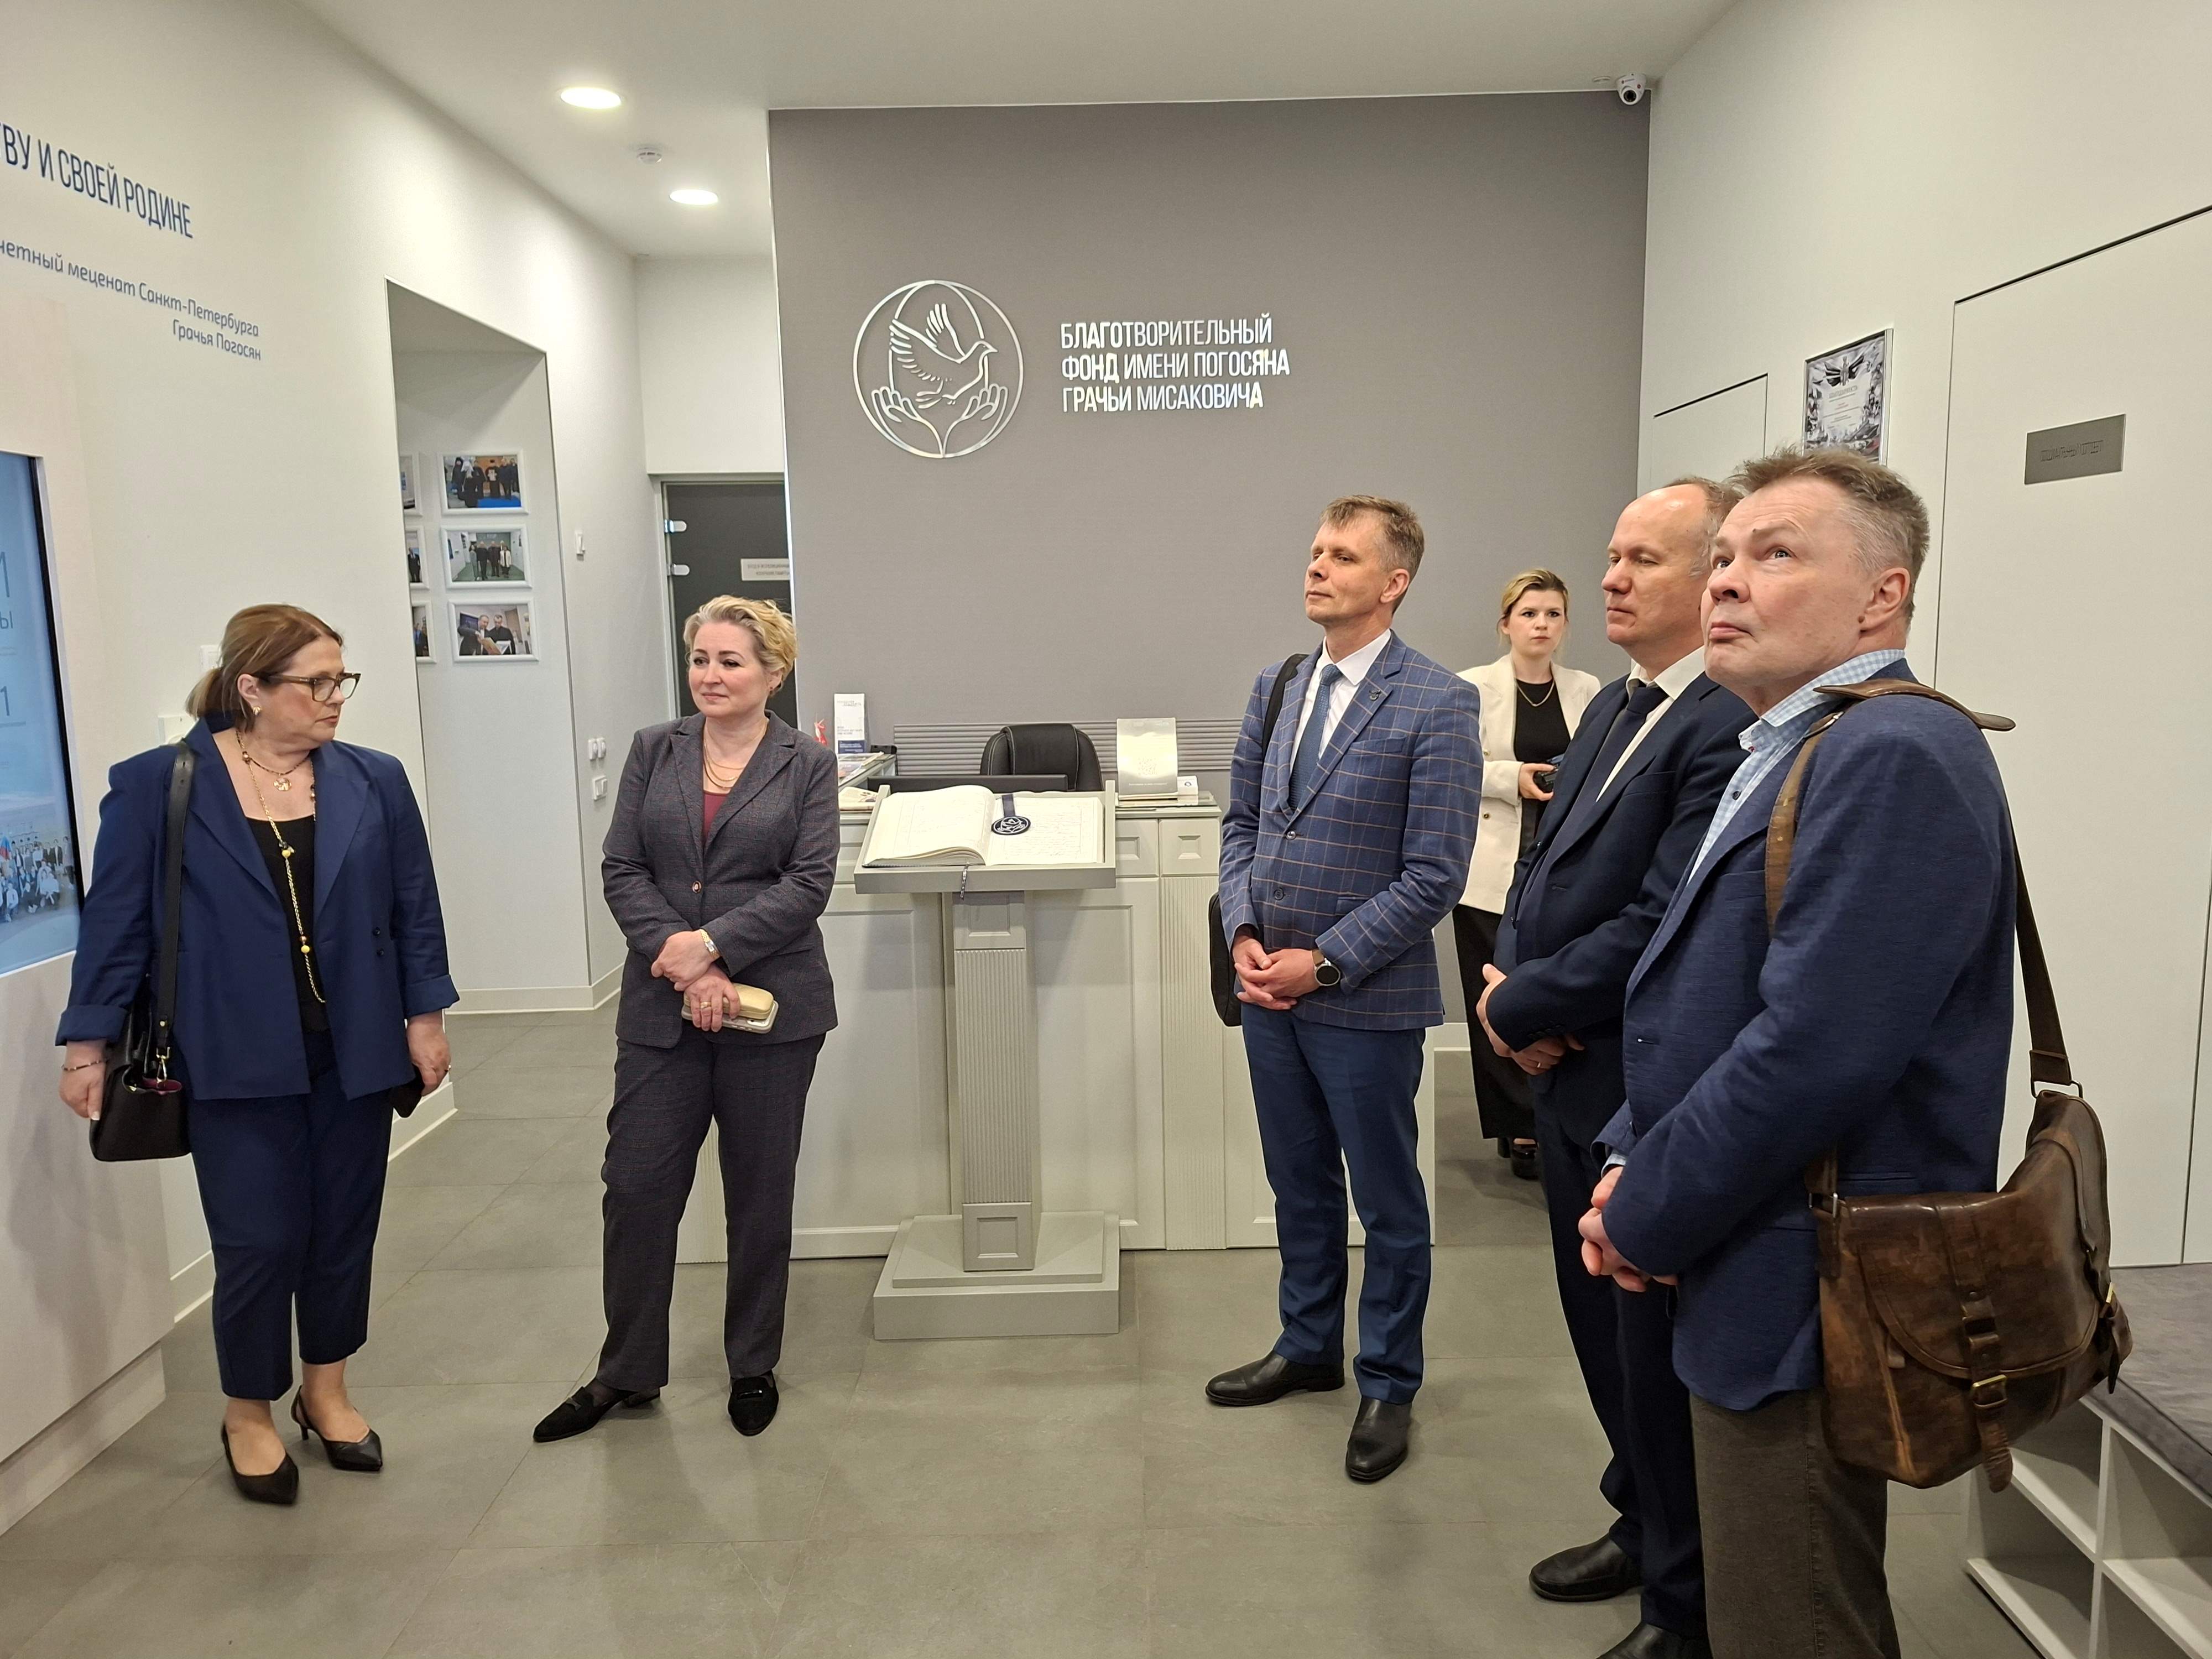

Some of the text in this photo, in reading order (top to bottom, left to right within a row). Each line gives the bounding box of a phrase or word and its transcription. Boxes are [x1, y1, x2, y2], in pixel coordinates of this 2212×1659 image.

[0, 122, 193, 238] ВУ И СВОЕЙ РОДИНЕ
[68, 262, 135, 297] меценат
[139, 283, 259, 337] Санкт-Петербурга
[173, 319, 261, 361] Грачья Погосян
[1061, 312, 1272, 349] БЛАГОТВОРИТЕЛЬНЫЙ
[1061, 349, 1290, 384] ФОНД ИМЕНИ ПОГОСЯНА
[1062, 382, 1264, 413] ГРАЧЬИ МИСАКОВИЧА
